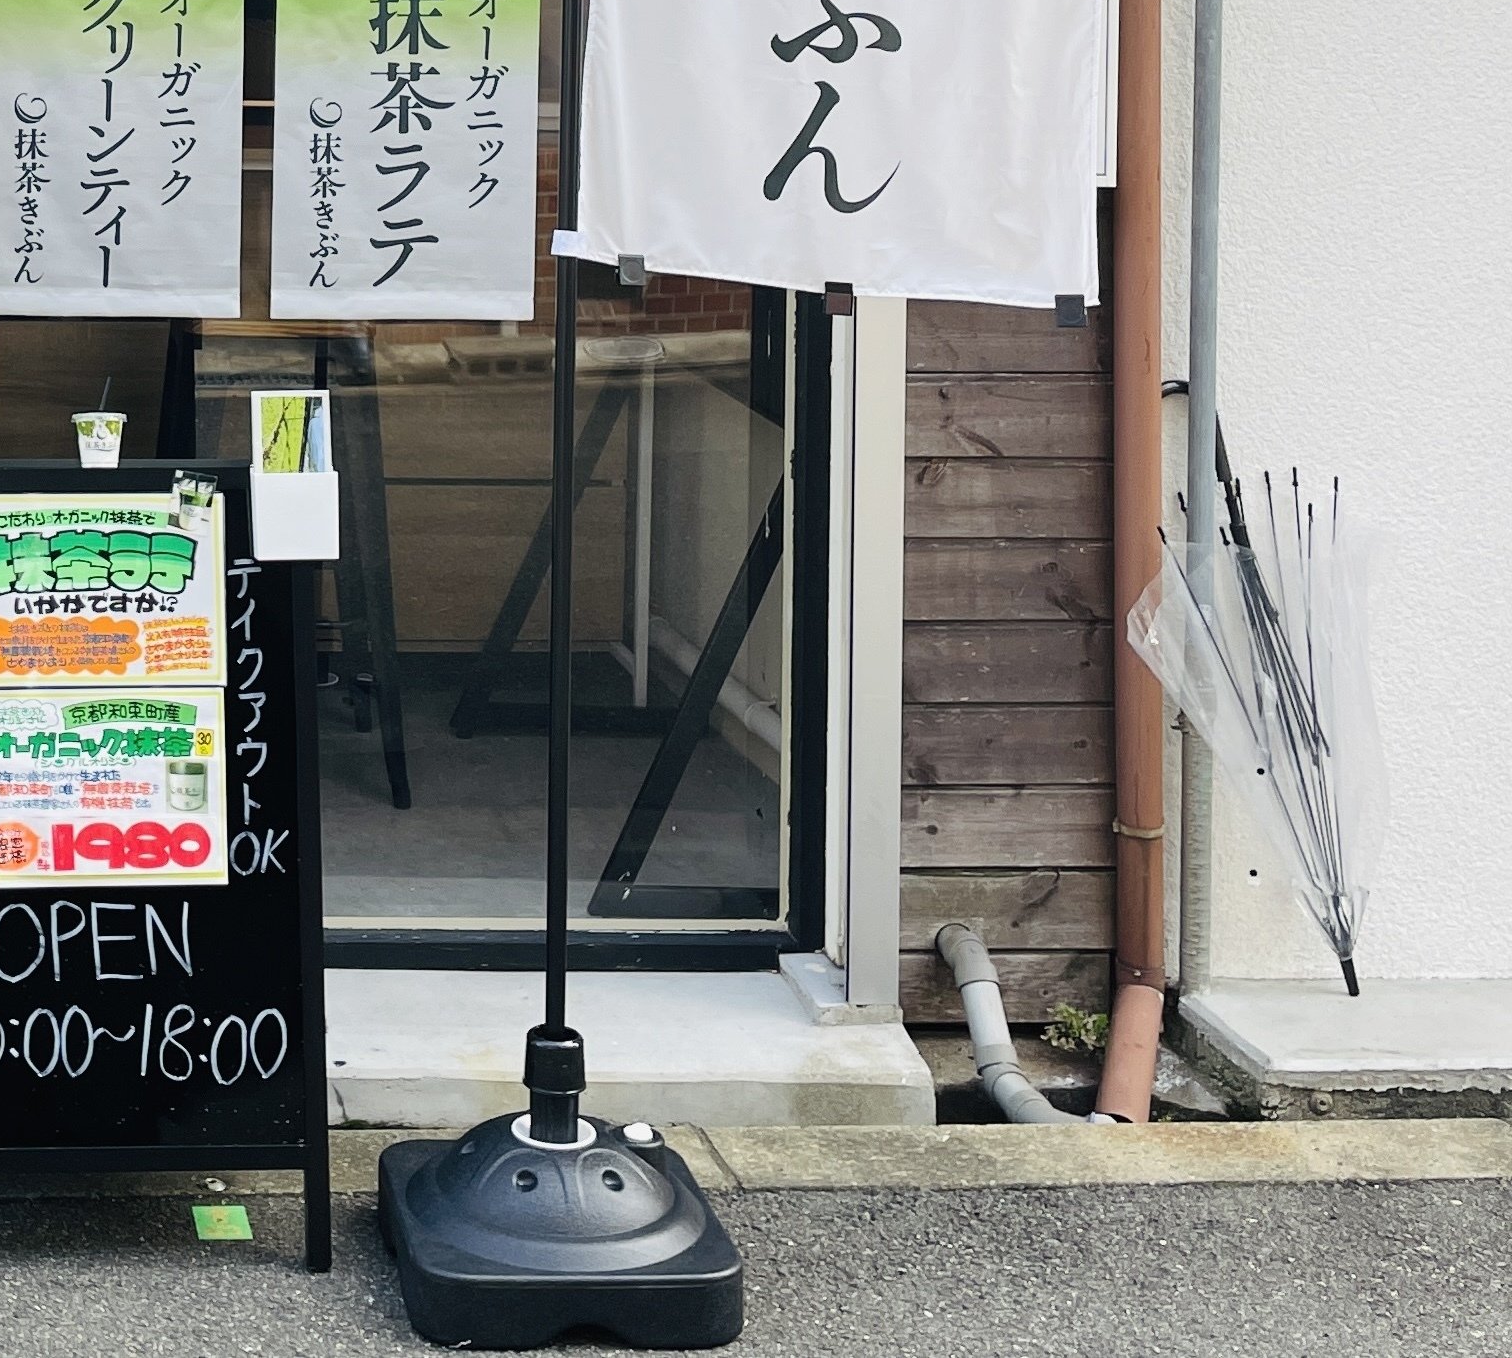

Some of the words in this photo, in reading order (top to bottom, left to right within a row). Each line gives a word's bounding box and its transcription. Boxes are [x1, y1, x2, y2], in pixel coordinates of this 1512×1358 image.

[13, 128, 51, 284] 抹茶きぶん
[308, 132, 346, 289] 抹茶きぶん
[52, 821, 211, 872] 1980
